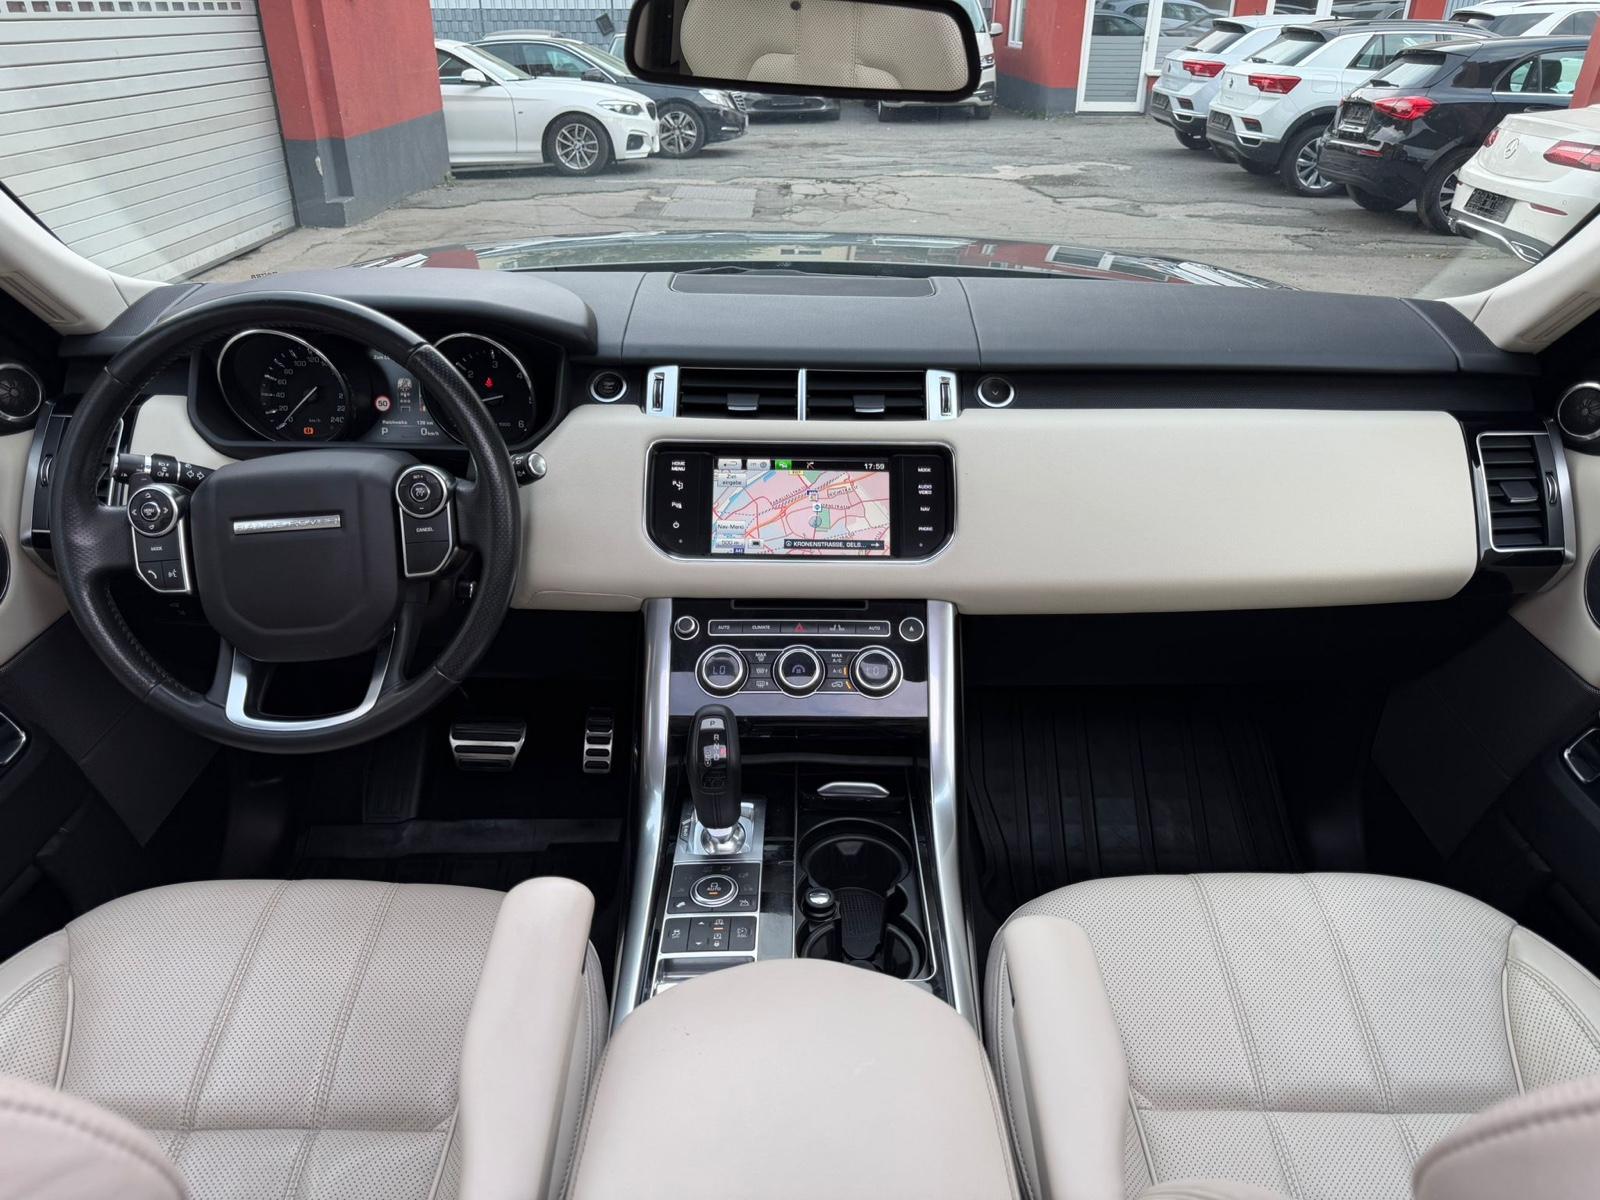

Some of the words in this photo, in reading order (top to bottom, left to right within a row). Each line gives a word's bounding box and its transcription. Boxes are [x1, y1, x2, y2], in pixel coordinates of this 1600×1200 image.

[294, 359, 307, 367] 100
[492, 361, 498, 369] 3
[284, 368, 293, 376] 80
[467, 371, 474, 379] 2
[276, 391, 286, 399] 40
[518, 421, 525, 429] 6
[382, 427, 389, 436] P
[421, 427, 428, 436] 0
[713, 733, 720, 741] R
[713, 753, 720, 761] D
